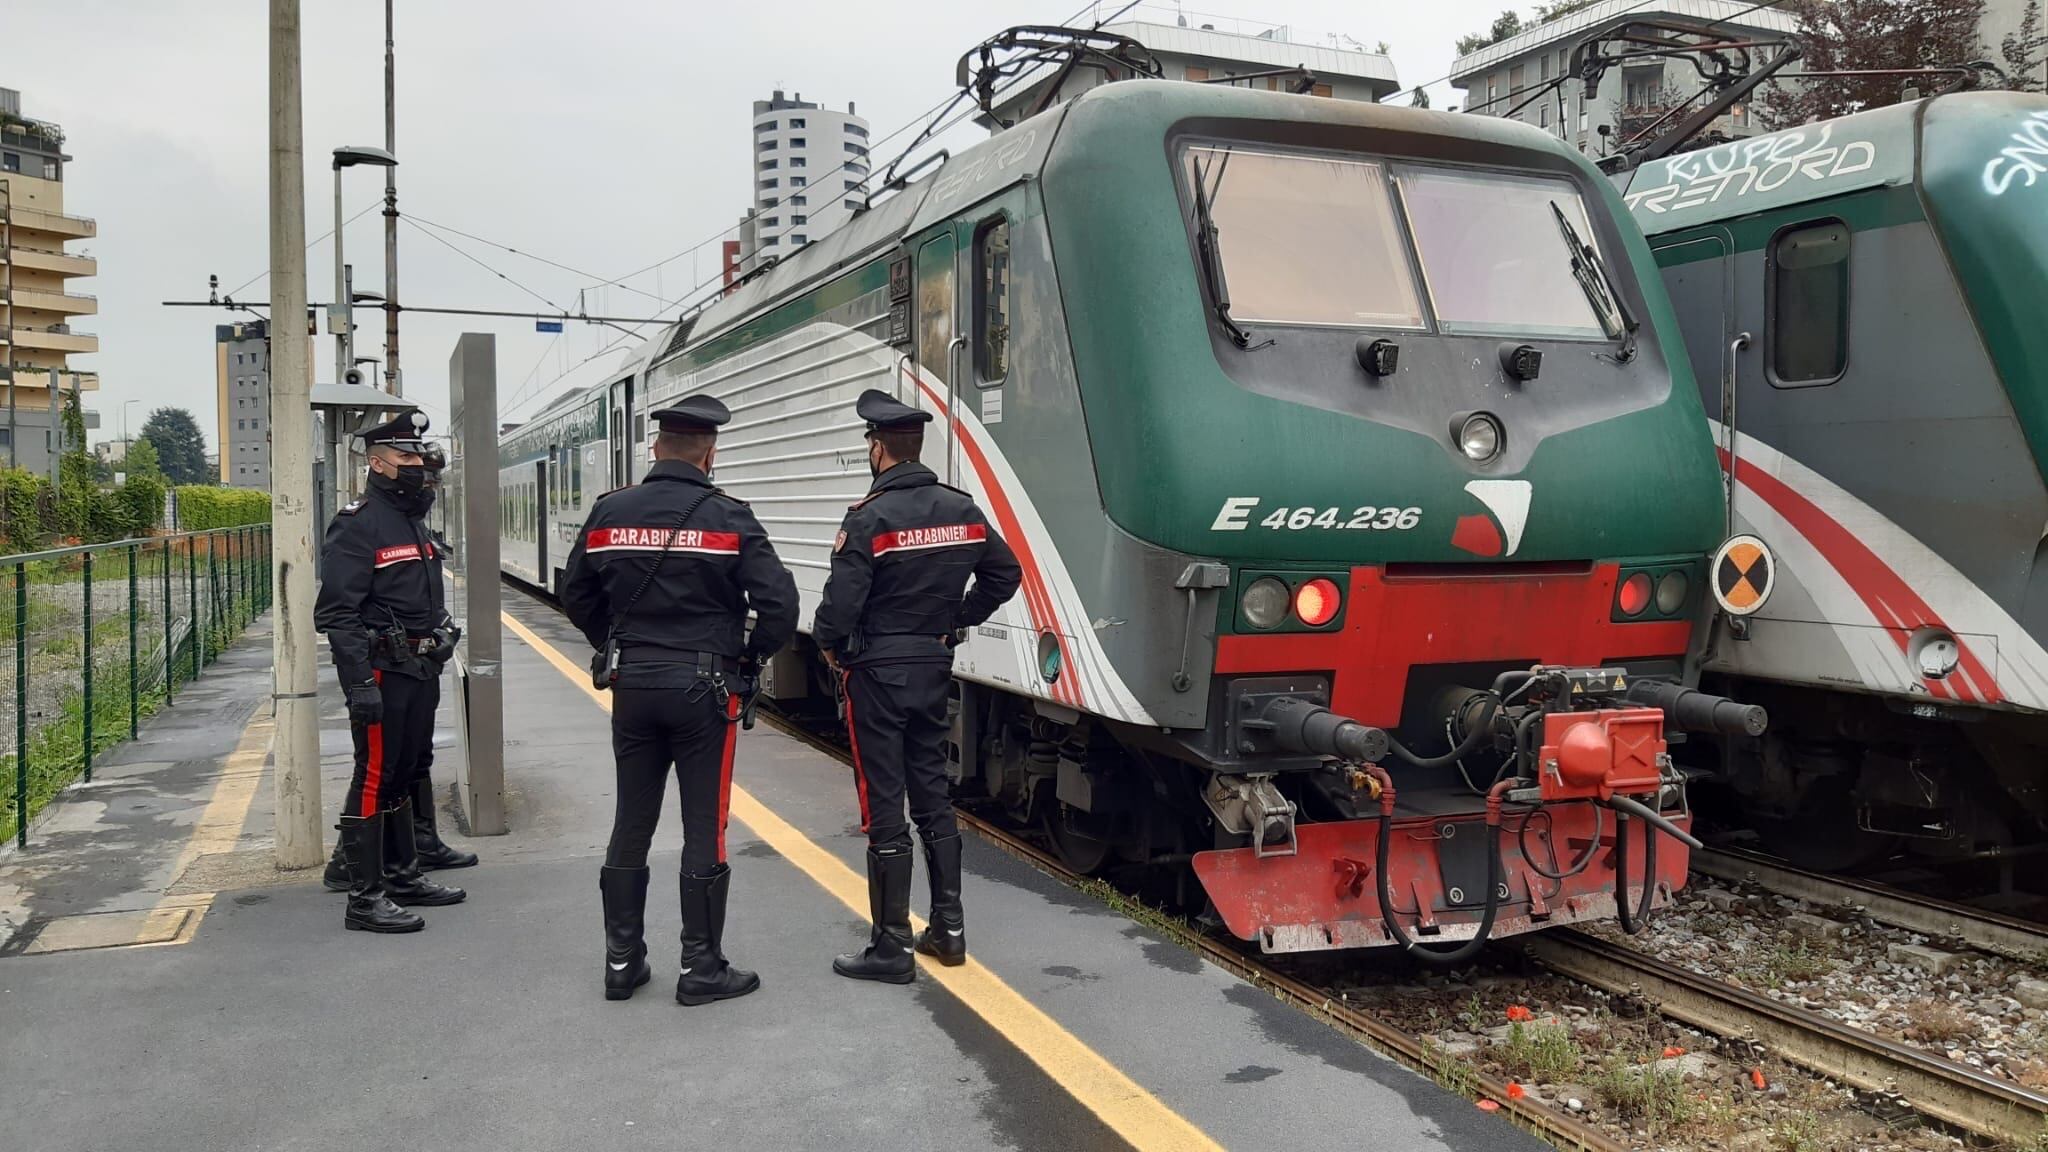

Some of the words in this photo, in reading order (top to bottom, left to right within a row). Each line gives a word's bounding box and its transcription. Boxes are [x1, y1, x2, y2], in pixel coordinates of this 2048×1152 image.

[1623, 141, 1876, 214] TRENORD
[1210, 497, 1260, 530] E
[1260, 506, 1423, 530] 464.236
[610, 528, 703, 546] CARABINIERI
[897, 525, 968, 547] CARABINIERI
